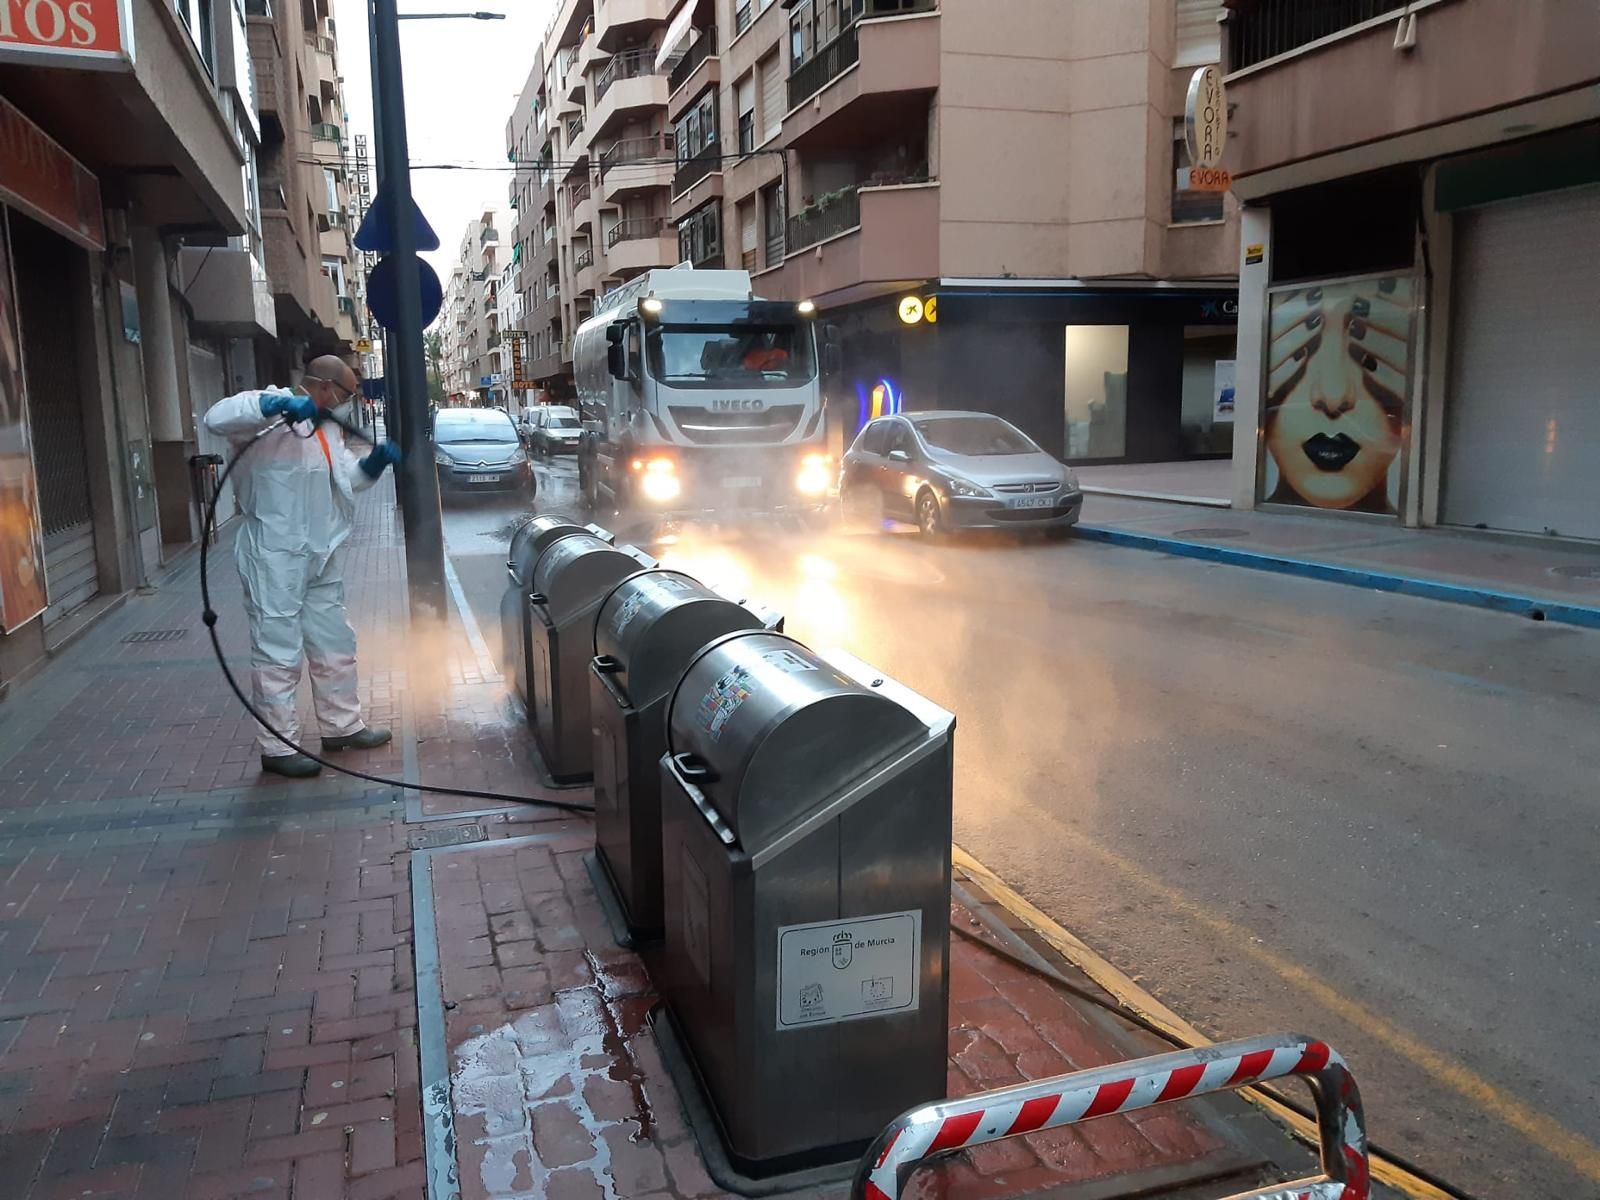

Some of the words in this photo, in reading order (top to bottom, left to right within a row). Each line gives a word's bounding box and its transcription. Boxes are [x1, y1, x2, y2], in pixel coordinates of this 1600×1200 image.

[1203, 69, 1214, 161] EVORA
[1190, 171, 1229, 185] EVORA
[712, 400, 764, 410] IVECO
[854, 940, 865, 949] de
[867, 938, 895, 948] Murcia
